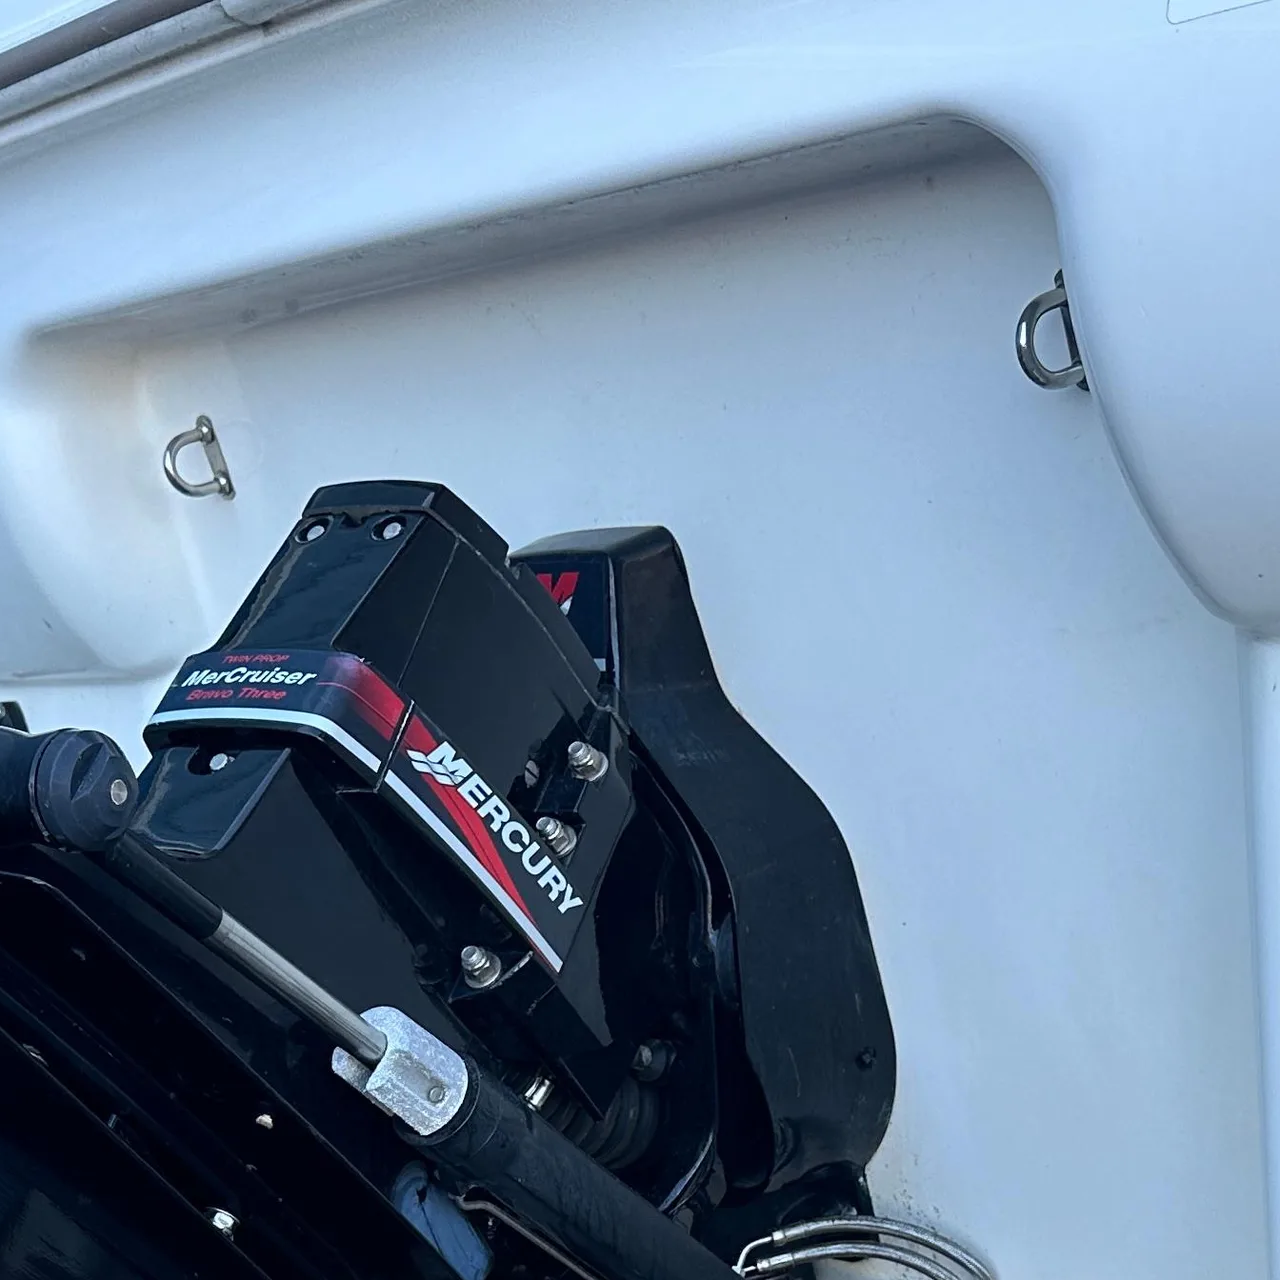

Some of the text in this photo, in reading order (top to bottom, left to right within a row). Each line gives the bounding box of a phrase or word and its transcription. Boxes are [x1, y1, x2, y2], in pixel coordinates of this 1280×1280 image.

[221, 653, 290, 664] TWIN PROP
[181, 666, 317, 688] MerCruiser
[186, 687, 288, 701] Bravo Three
[425, 740, 584, 914] MERCURY
